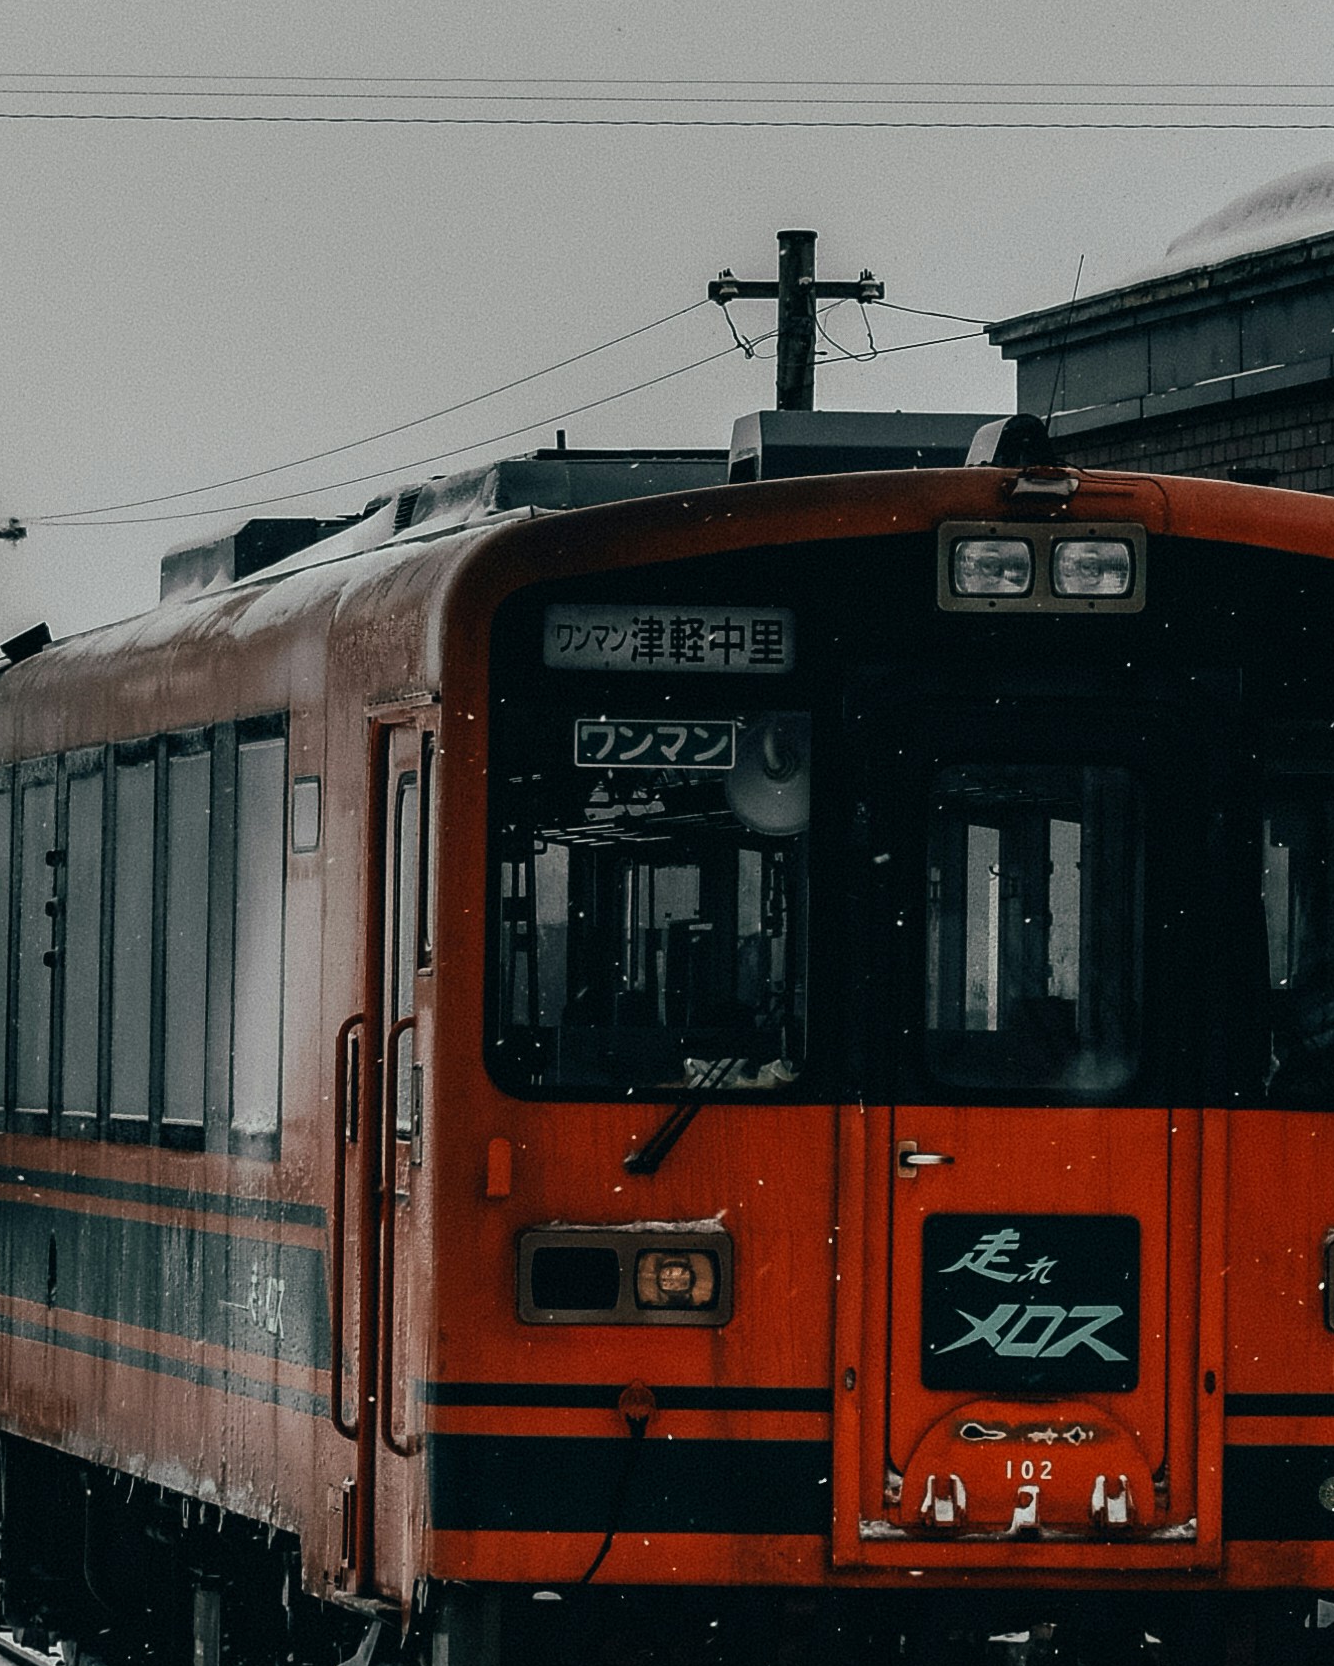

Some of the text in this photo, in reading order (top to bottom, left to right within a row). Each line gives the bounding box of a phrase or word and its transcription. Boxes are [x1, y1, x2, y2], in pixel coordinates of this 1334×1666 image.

[556, 614, 785, 666] ワンマン 津軽中里
[580, 725, 730, 763] ワンマン
[937, 1227, 1059, 1284] 走れ
[933, 1304, 1130, 1362] メロス
[1005, 1459, 1054, 1481] 102
